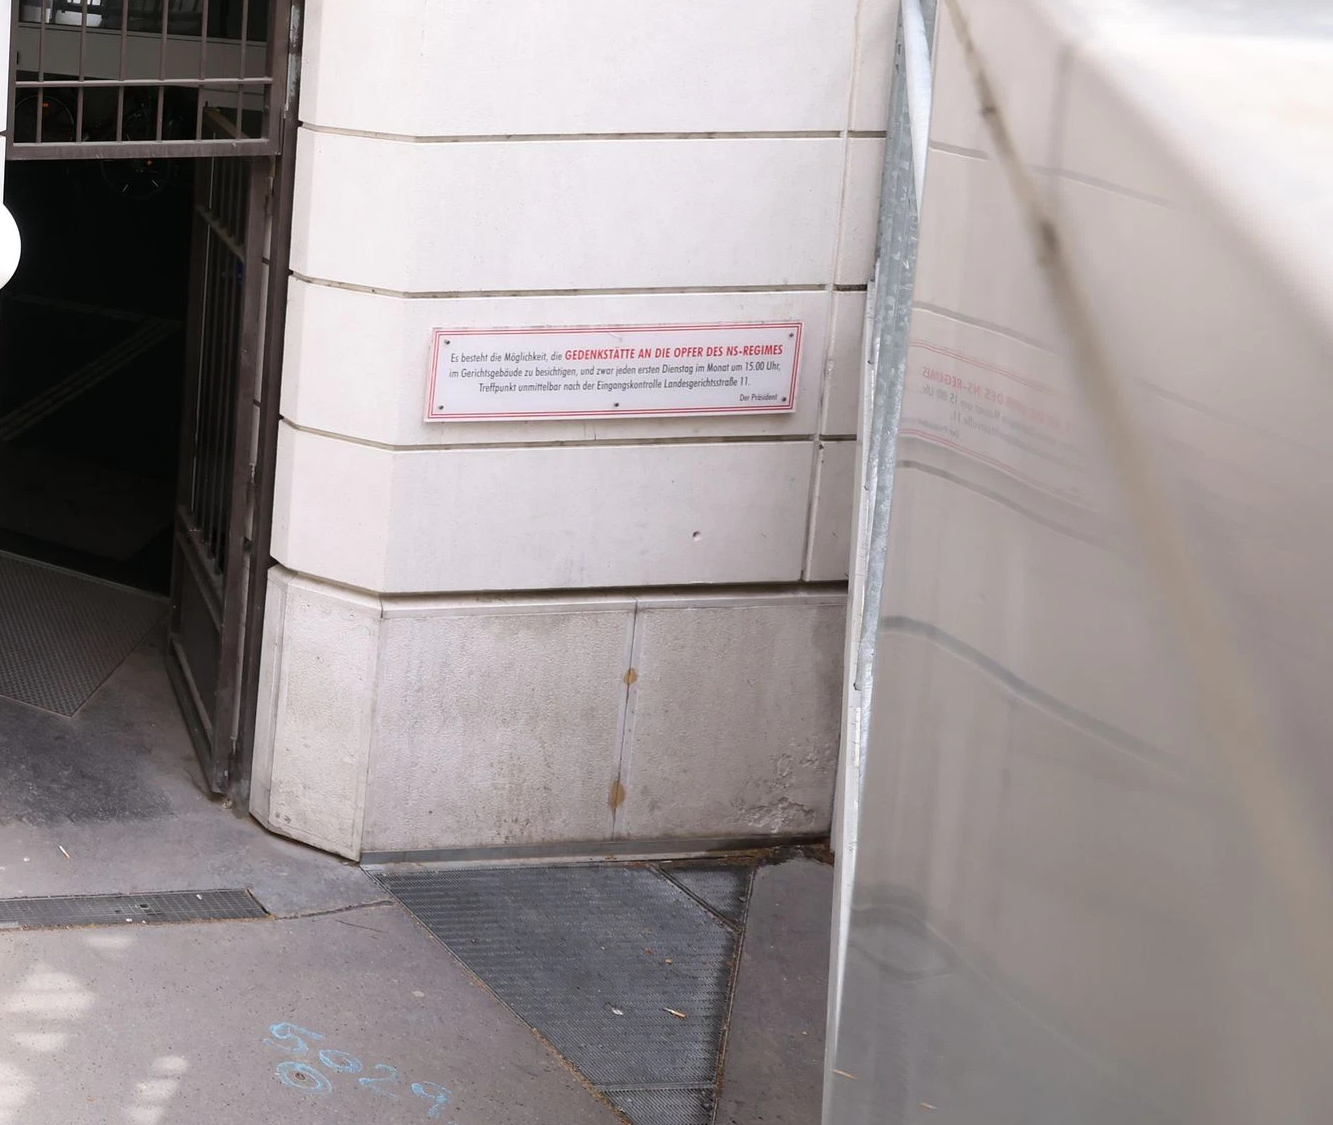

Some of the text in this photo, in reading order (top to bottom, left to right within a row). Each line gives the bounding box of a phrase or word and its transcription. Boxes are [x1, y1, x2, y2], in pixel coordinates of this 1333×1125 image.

[451, 344, 783, 364] Es besteht die Möglichkeit, die GEDENKSTÄTTE AN DIE OPFER DES NS-REGIMES
[449, 360, 781, 380] im Gerichtsgebäude zu besichtigen, und zwar jeden ersten Dienstag im Monat um 15.00 Uhr,
[479, 376, 751, 394] Treffpunkt unmittelbar nach der Eingangskontrolle Landesgerichtsstraße 11.
[739, 393, 778, 402] Der Präsident
